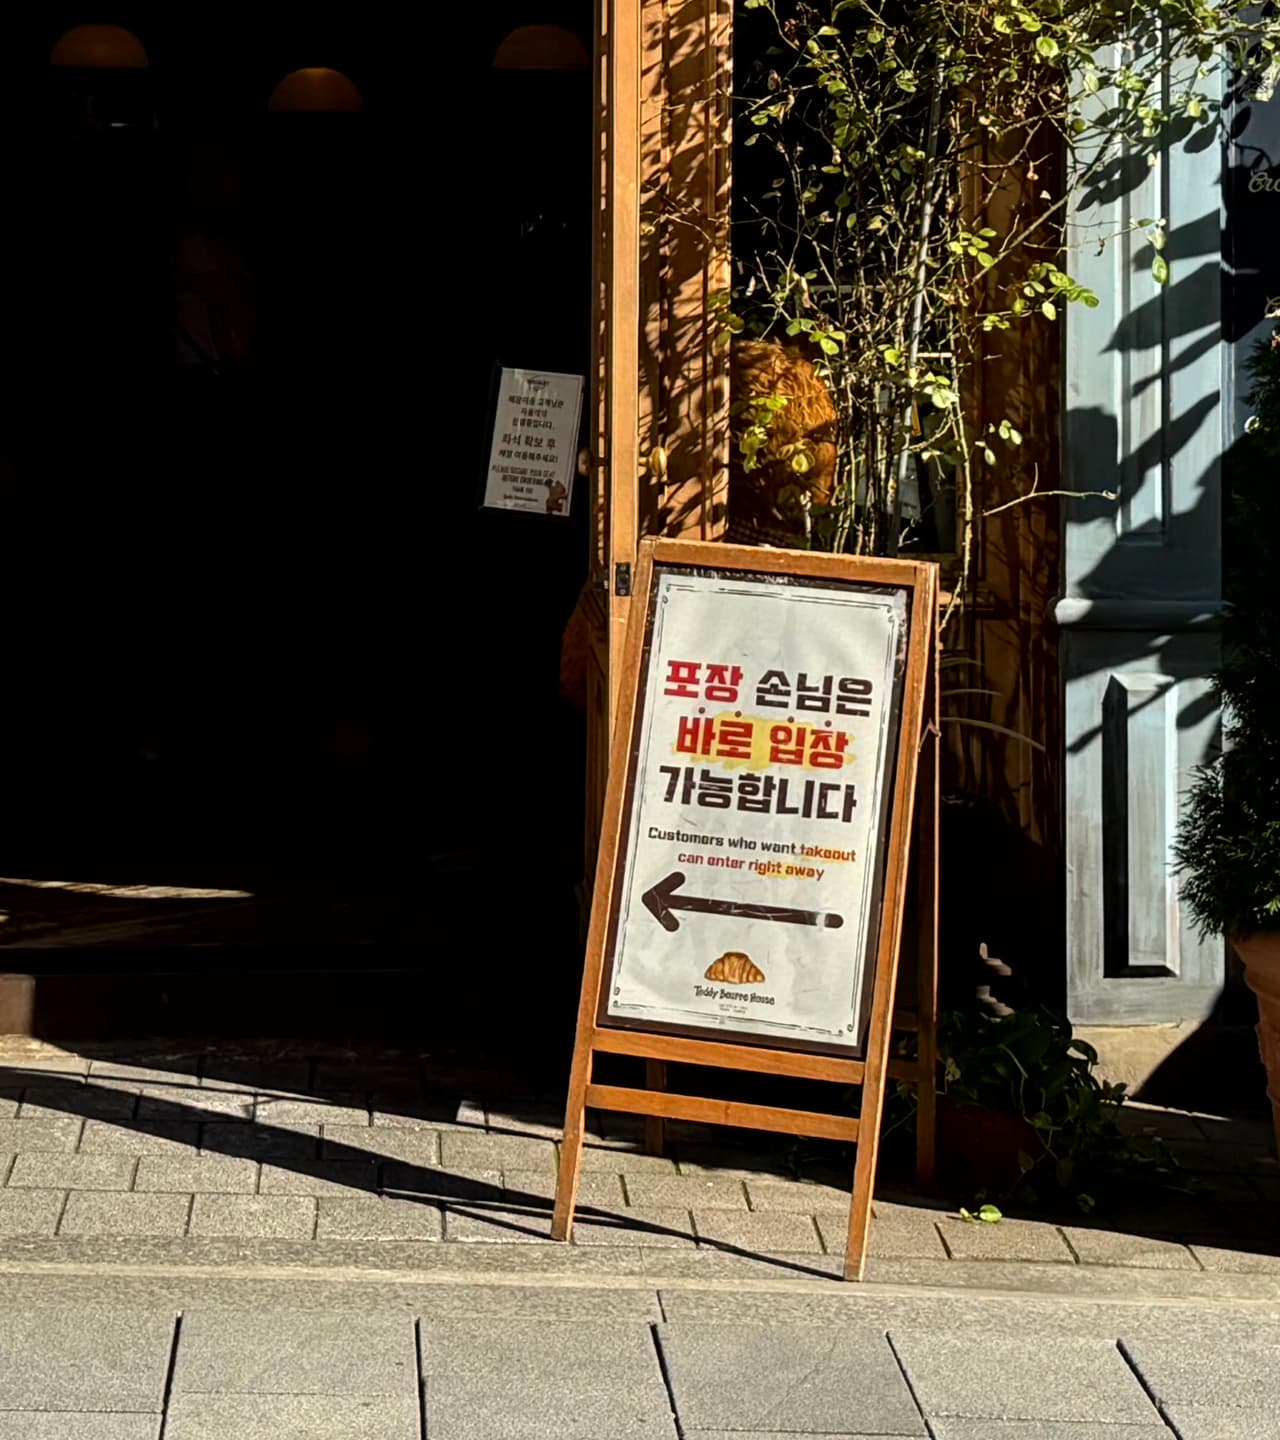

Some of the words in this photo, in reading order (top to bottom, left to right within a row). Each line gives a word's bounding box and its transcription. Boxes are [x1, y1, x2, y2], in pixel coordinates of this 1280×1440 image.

[664, 660, 743, 703] 포장
[755, 669, 873, 717] 손님은
[676, 716, 754, 759] 바로
[769, 724, 849, 769] 입장
[659, 765, 857, 823] 가능합니다
[648, 826, 724, 847] Customers
[728, 836, 757, 851] who
[761, 840, 796, 855] want
[800, 844, 856, 862] takeout
[678, 852, 704, 865] can
[707, 857, 745, 870] enter
[748, 860, 782, 876] right
[785, 866, 825, 881] away
